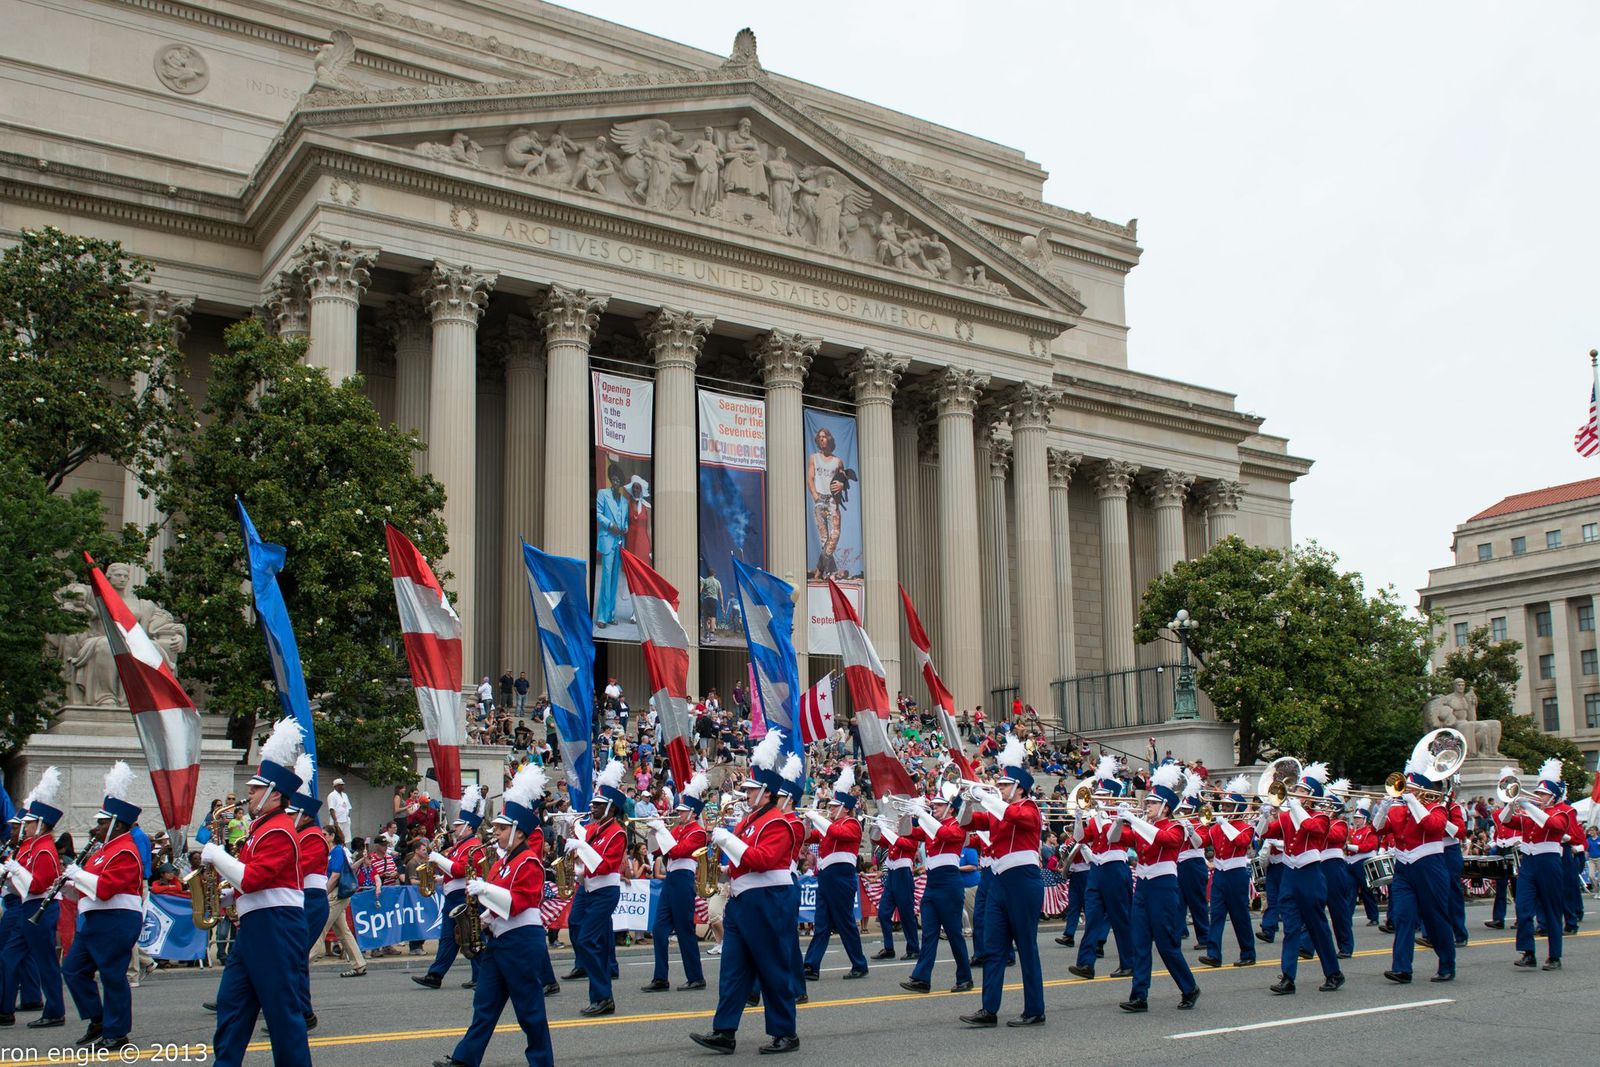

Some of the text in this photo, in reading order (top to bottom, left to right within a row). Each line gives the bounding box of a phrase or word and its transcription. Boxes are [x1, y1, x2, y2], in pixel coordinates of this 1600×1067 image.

[502, 220, 941, 331] ARCHIVES OF THE UNITED STATES OF AMERICA
[602, 381, 631, 397] Opening
[602, 393, 631, 407] March 8
[610, 407, 621, 417] the
[719, 400, 763, 418] Searching
[735, 414, 764, 427] for the
[719, 423, 765, 440] Seventies:
[722, 454, 749, 465] photography
[355, 901, 425, 938] Sprint
